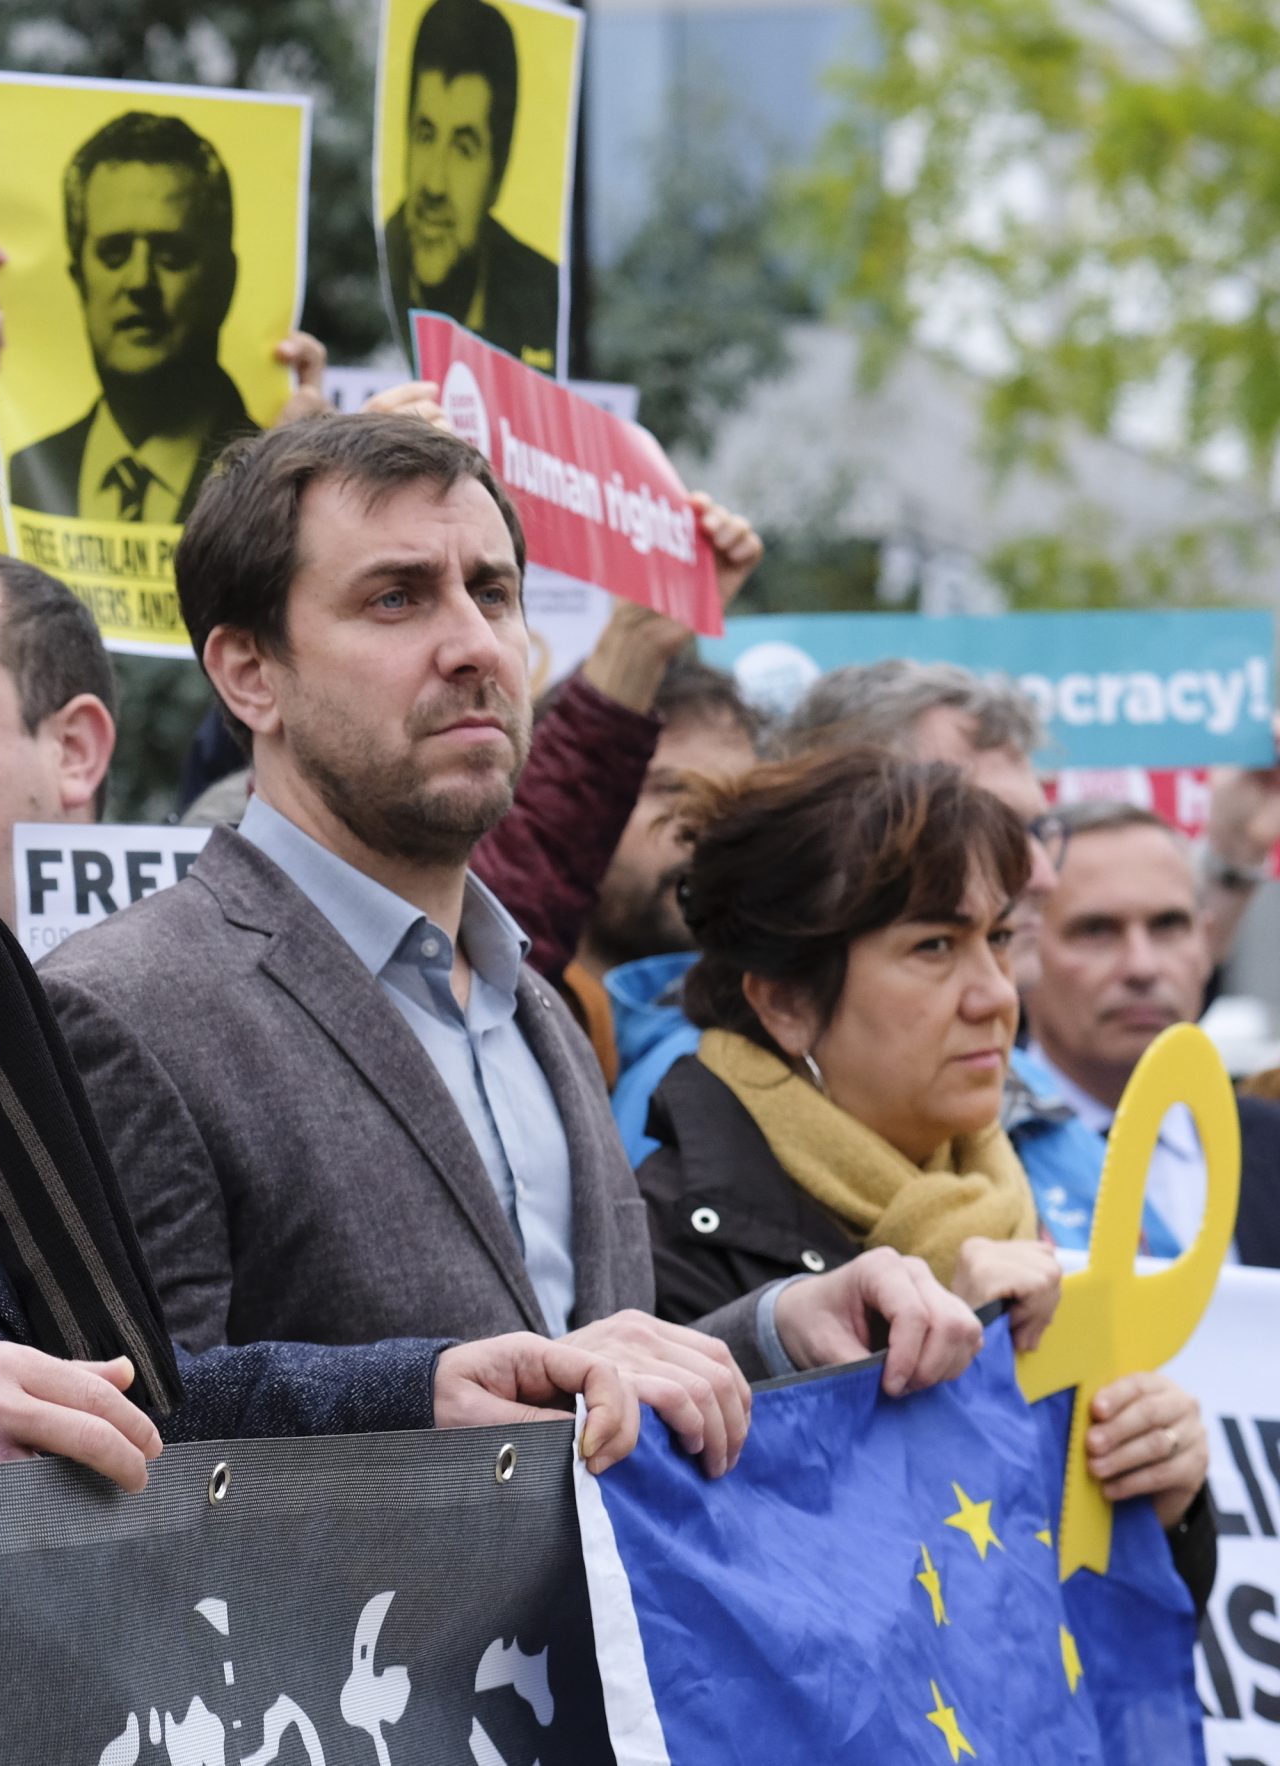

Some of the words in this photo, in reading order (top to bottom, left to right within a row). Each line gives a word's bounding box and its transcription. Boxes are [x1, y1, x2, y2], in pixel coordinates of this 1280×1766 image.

[500, 416, 604, 524] human
[603, 472, 697, 567] rights!
[62, 530, 150, 579] CATALAN
[1016, 656, 1270, 734] ocracy!
